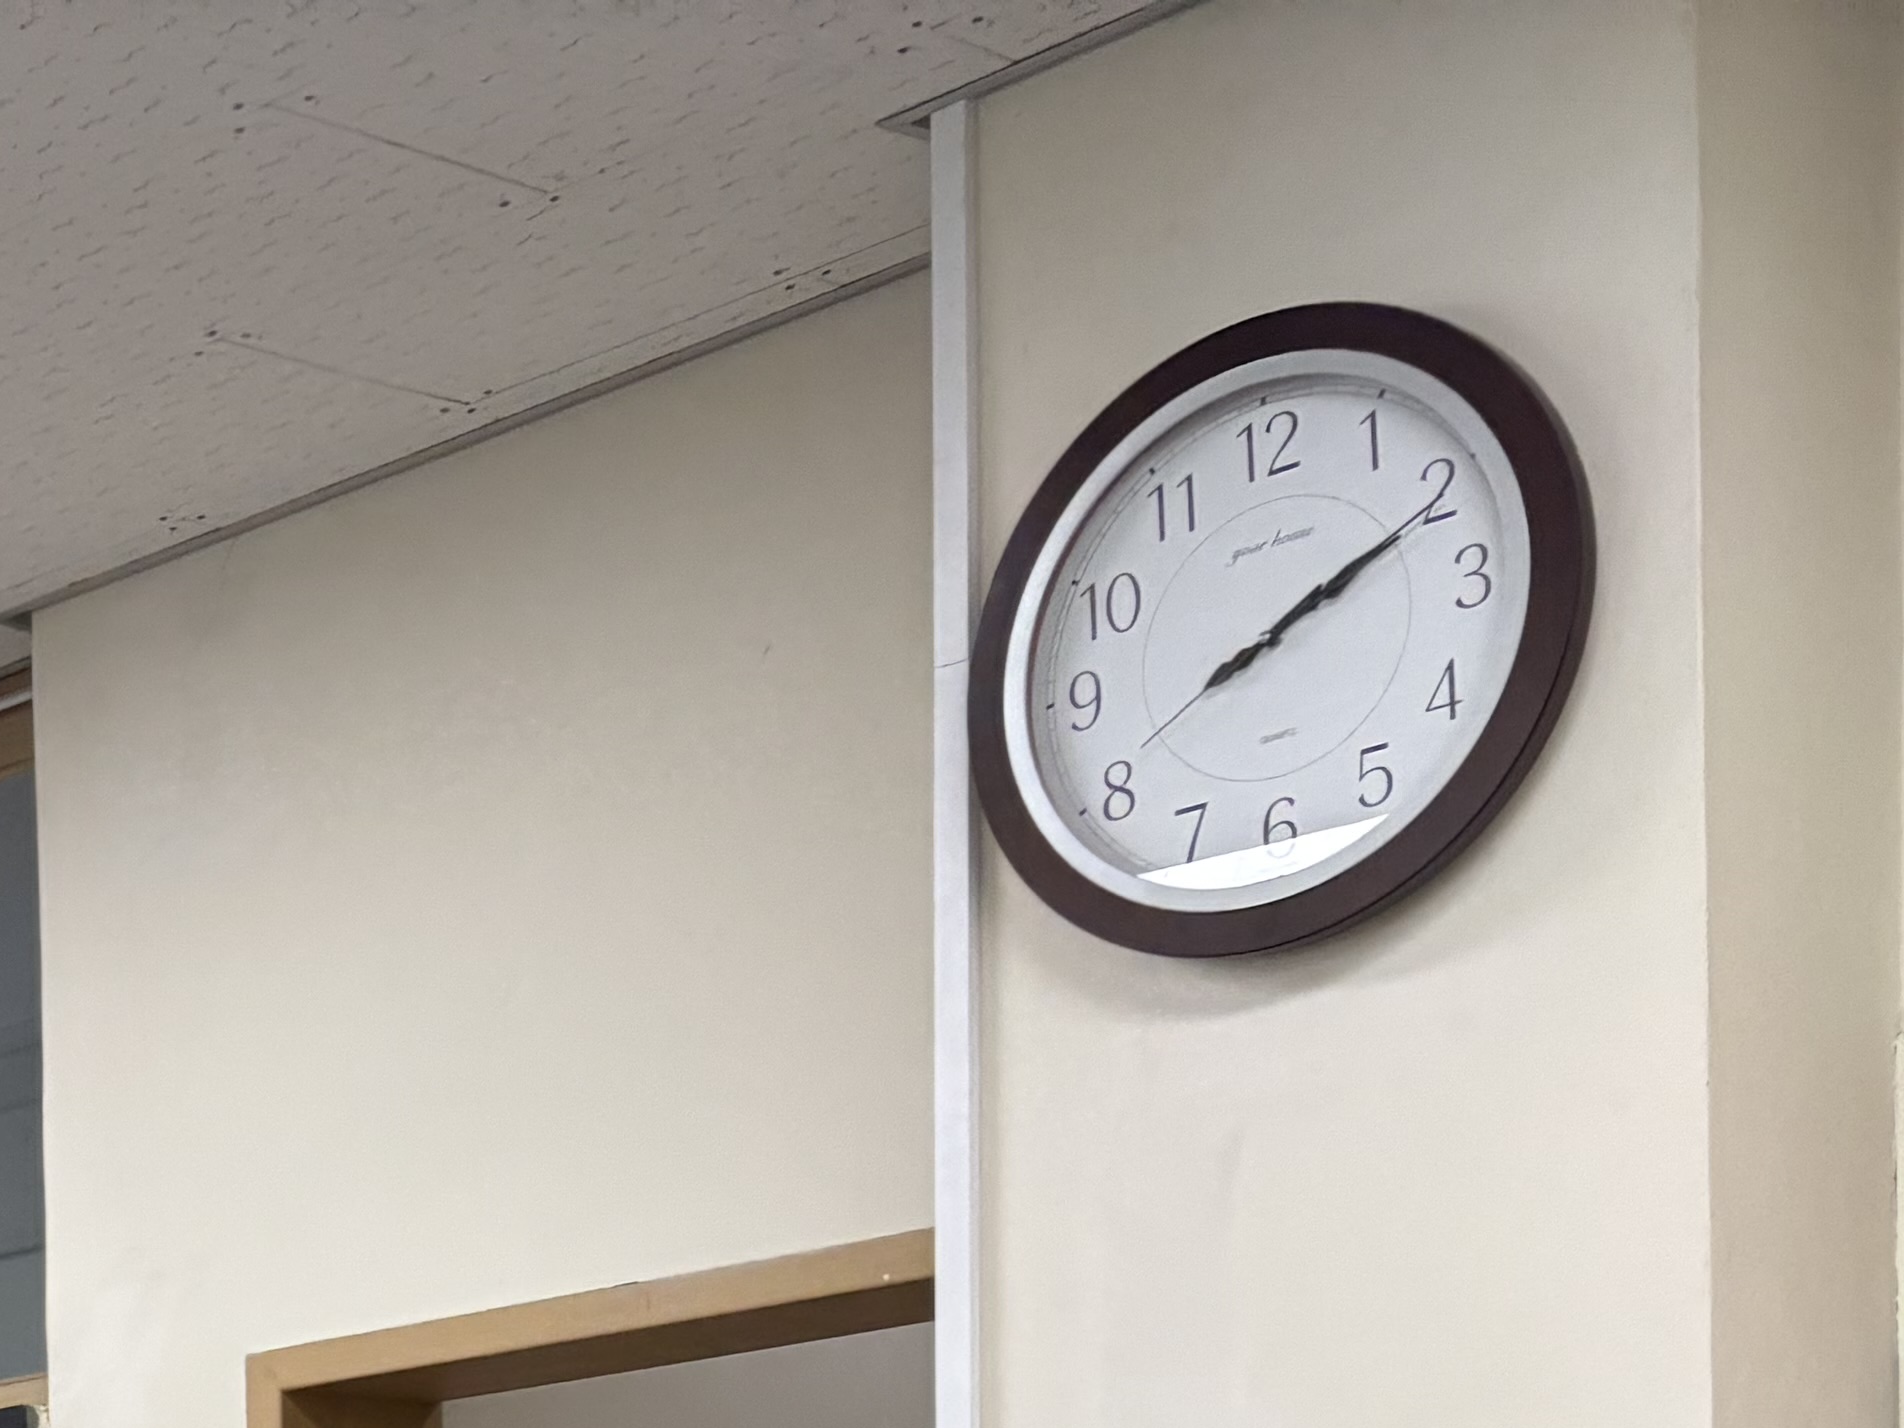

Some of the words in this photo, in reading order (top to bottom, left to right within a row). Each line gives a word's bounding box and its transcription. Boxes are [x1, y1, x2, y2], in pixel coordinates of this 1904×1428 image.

[1235, 410, 1301, 483] 12
[1358, 408, 1380, 472] 1
[1148, 473, 1196, 542] 11
[1419, 457, 1458, 526] 2
[1084, 571, 1142, 640] 10
[1454, 543, 1493, 609] 3
[1069, 670, 1102, 732] 9
[1425, 658, 1462, 721] 4
[1103, 760, 1134, 821] 8
[1357, 742, 1394, 808] 5
[1174, 802, 1209, 864] 7
[1262, 796, 1298, 859] 6
